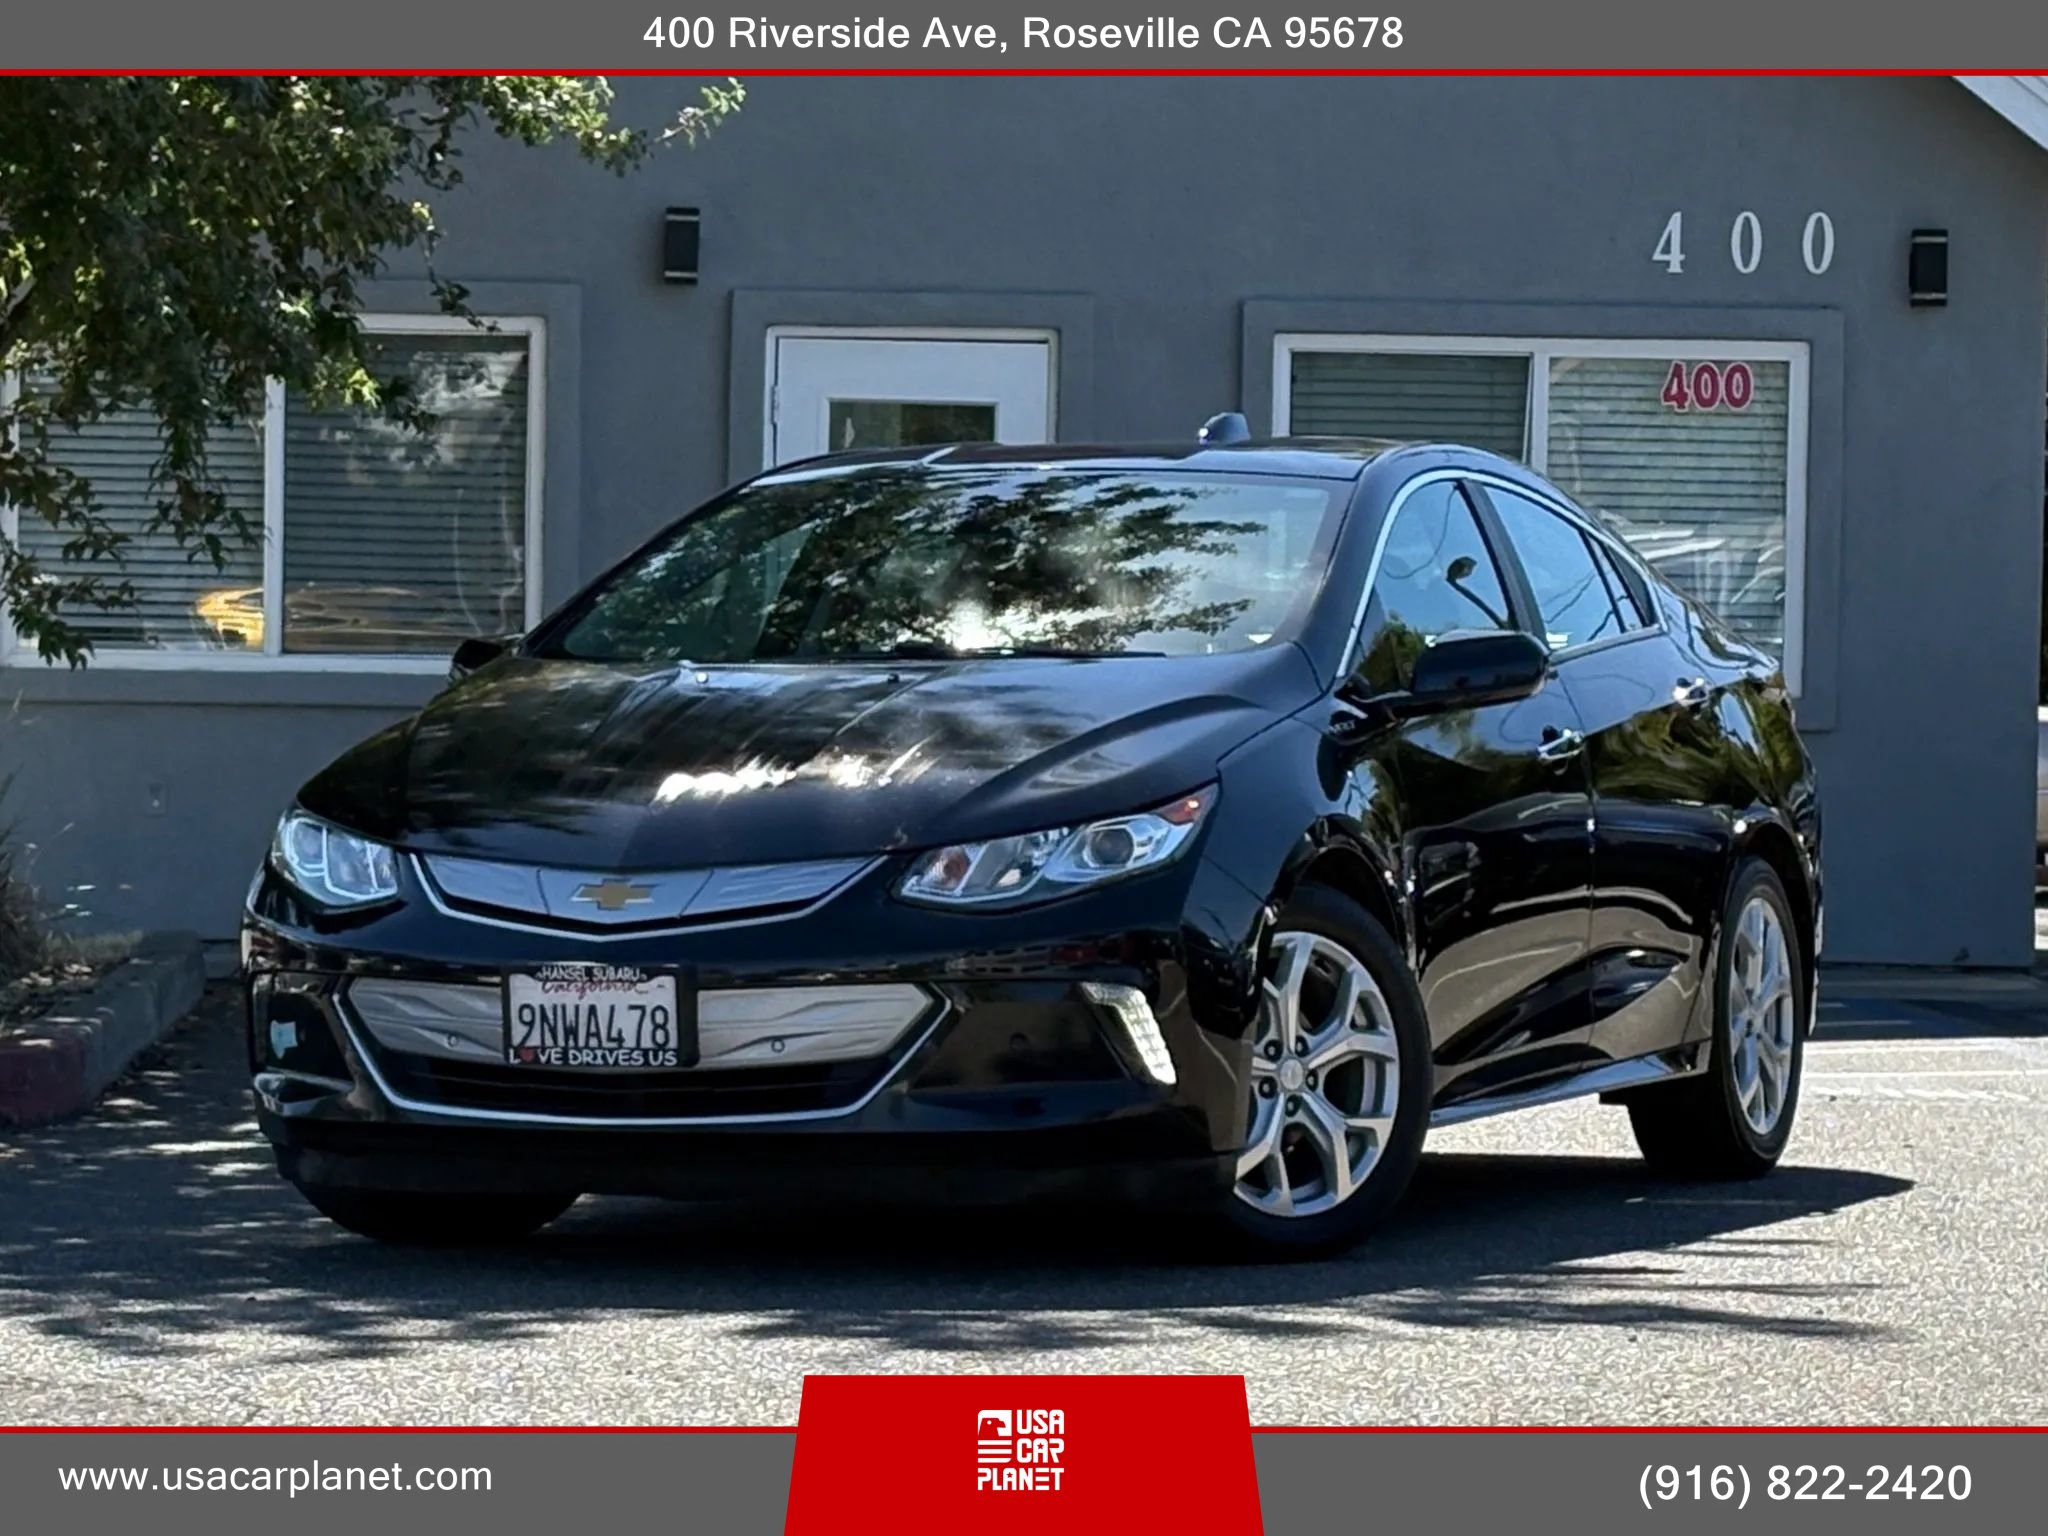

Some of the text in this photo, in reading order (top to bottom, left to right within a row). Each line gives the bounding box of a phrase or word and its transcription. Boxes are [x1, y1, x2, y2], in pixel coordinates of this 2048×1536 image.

[1651, 211, 1835, 275] 400
[1661, 361, 1754, 412] 400
[541, 965, 641, 981] HANSEL SUBARU
[518, 1003, 671, 1048] 9NWA478
[568, 1049, 645, 1065] DRIVES
[649, 1050, 678, 1066] US
